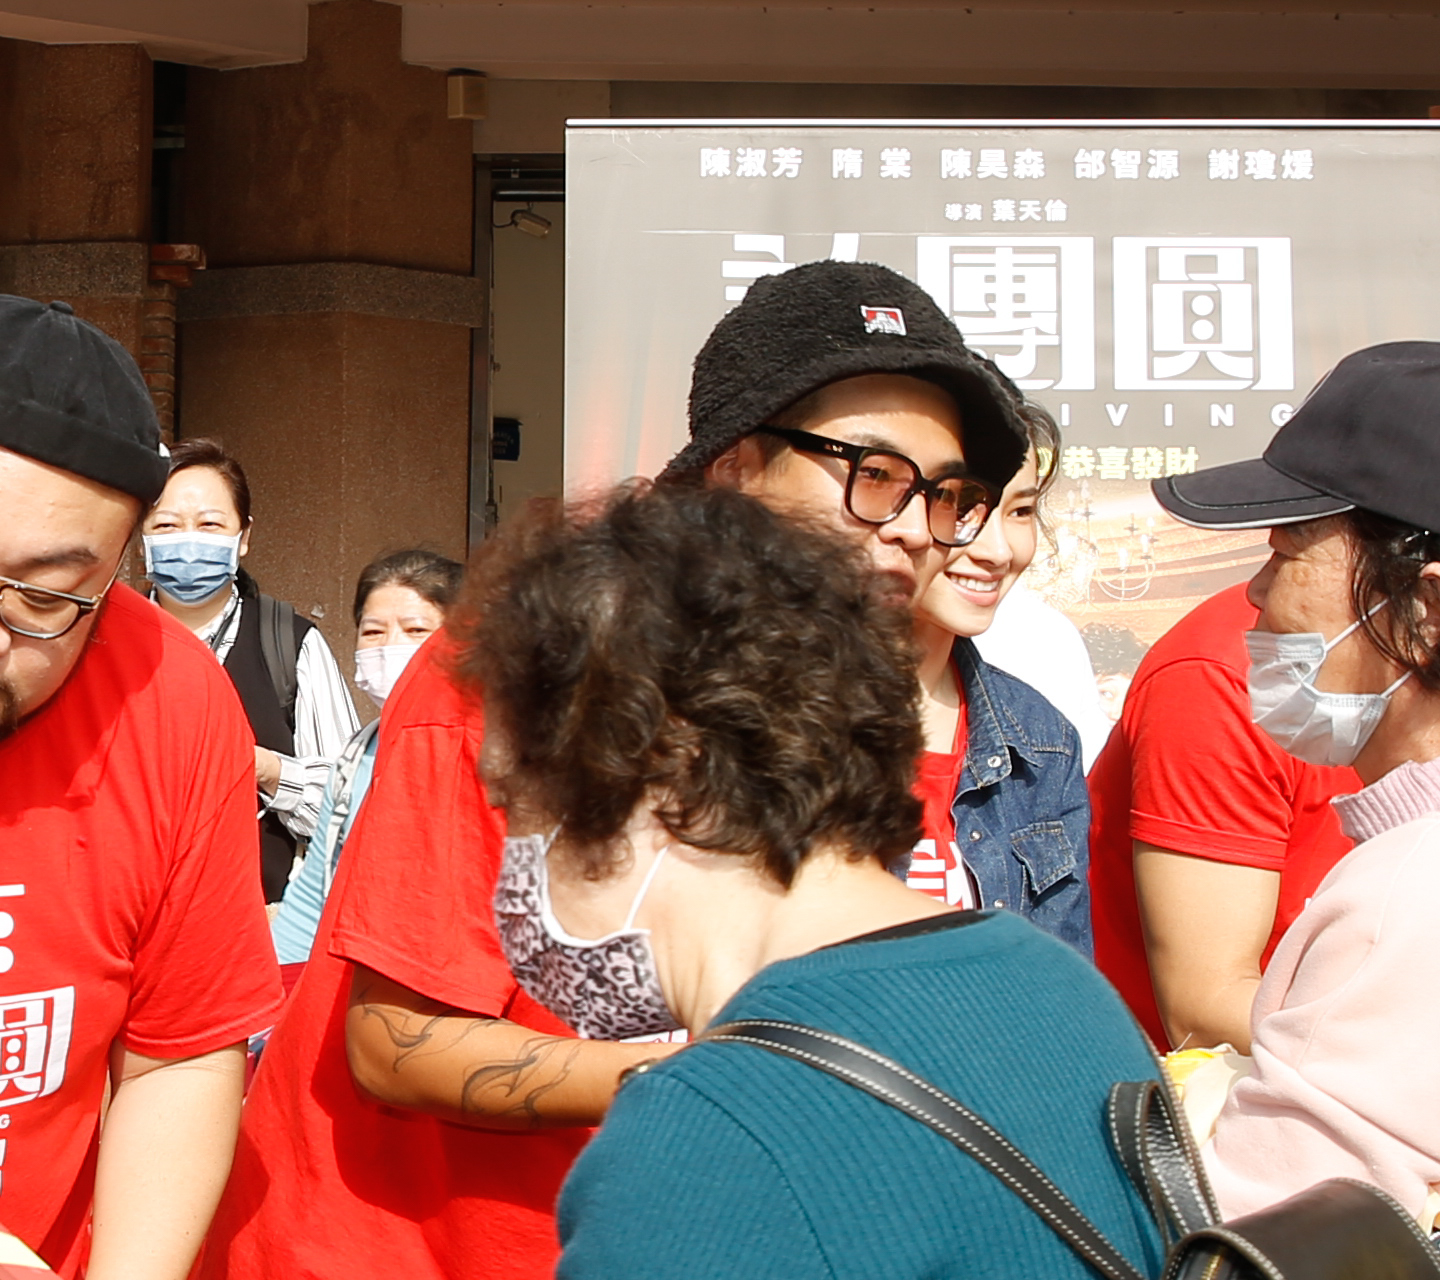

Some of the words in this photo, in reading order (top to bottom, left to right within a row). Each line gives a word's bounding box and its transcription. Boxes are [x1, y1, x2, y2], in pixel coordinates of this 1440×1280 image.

[700, 147, 803, 179] 陳淑芳
[940, 148, 1046, 179] 陳昊森
[1073, 148, 1181, 180] 邰智源
[992, 198, 1069, 222] 葉天倫
[1062, 446, 1200, 480] 恭喜發財
